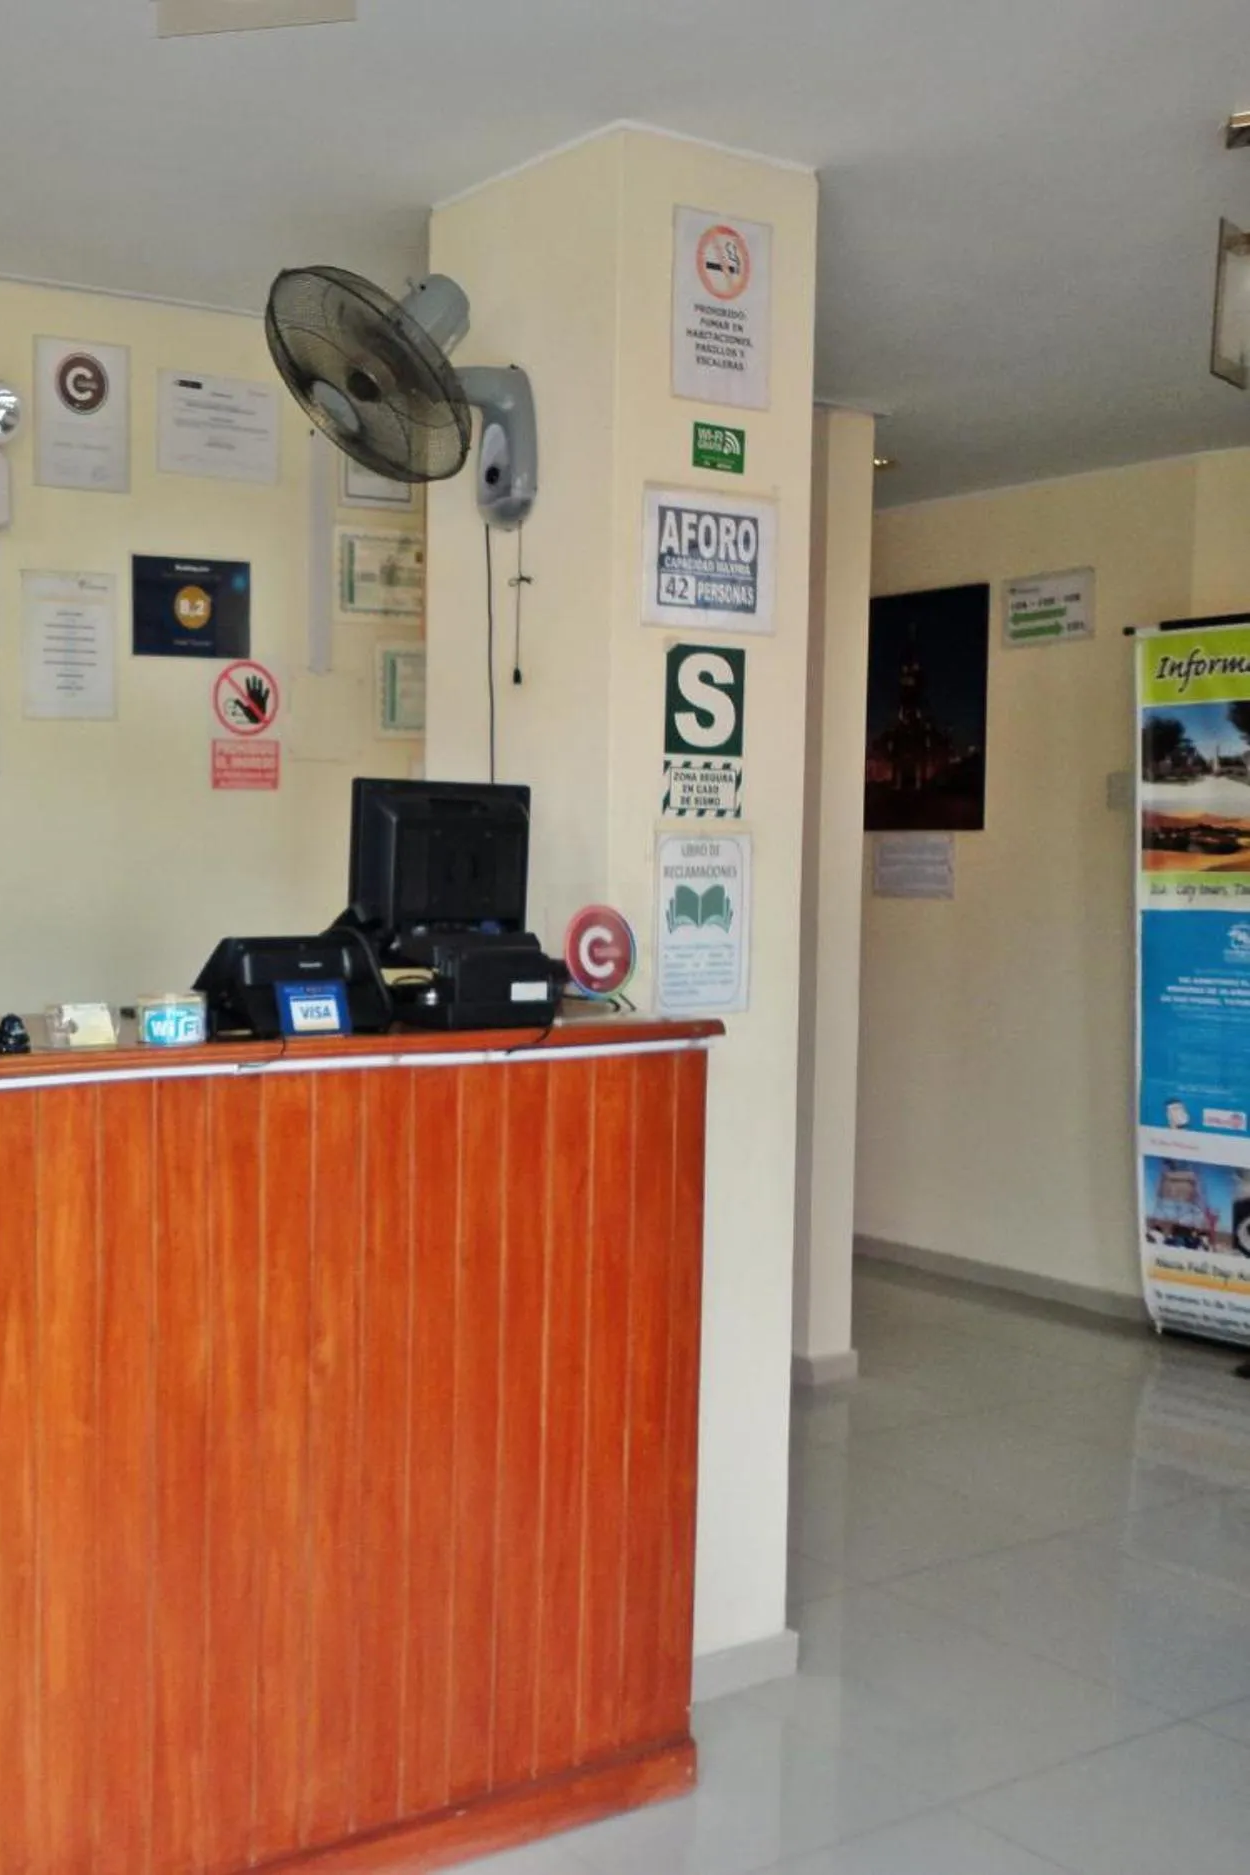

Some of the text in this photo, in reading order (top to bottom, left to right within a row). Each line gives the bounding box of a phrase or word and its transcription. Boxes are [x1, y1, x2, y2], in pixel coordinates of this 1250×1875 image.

[659, 509, 757, 563] AFORO
[664, 576, 755, 607] 42 PERSONAS
[673, 652, 737, 748] S
[672, 771, 734, 784] ZONA SEGURA
[681, 784, 695, 794] EN
[299, 1004, 333, 1020] VISA
